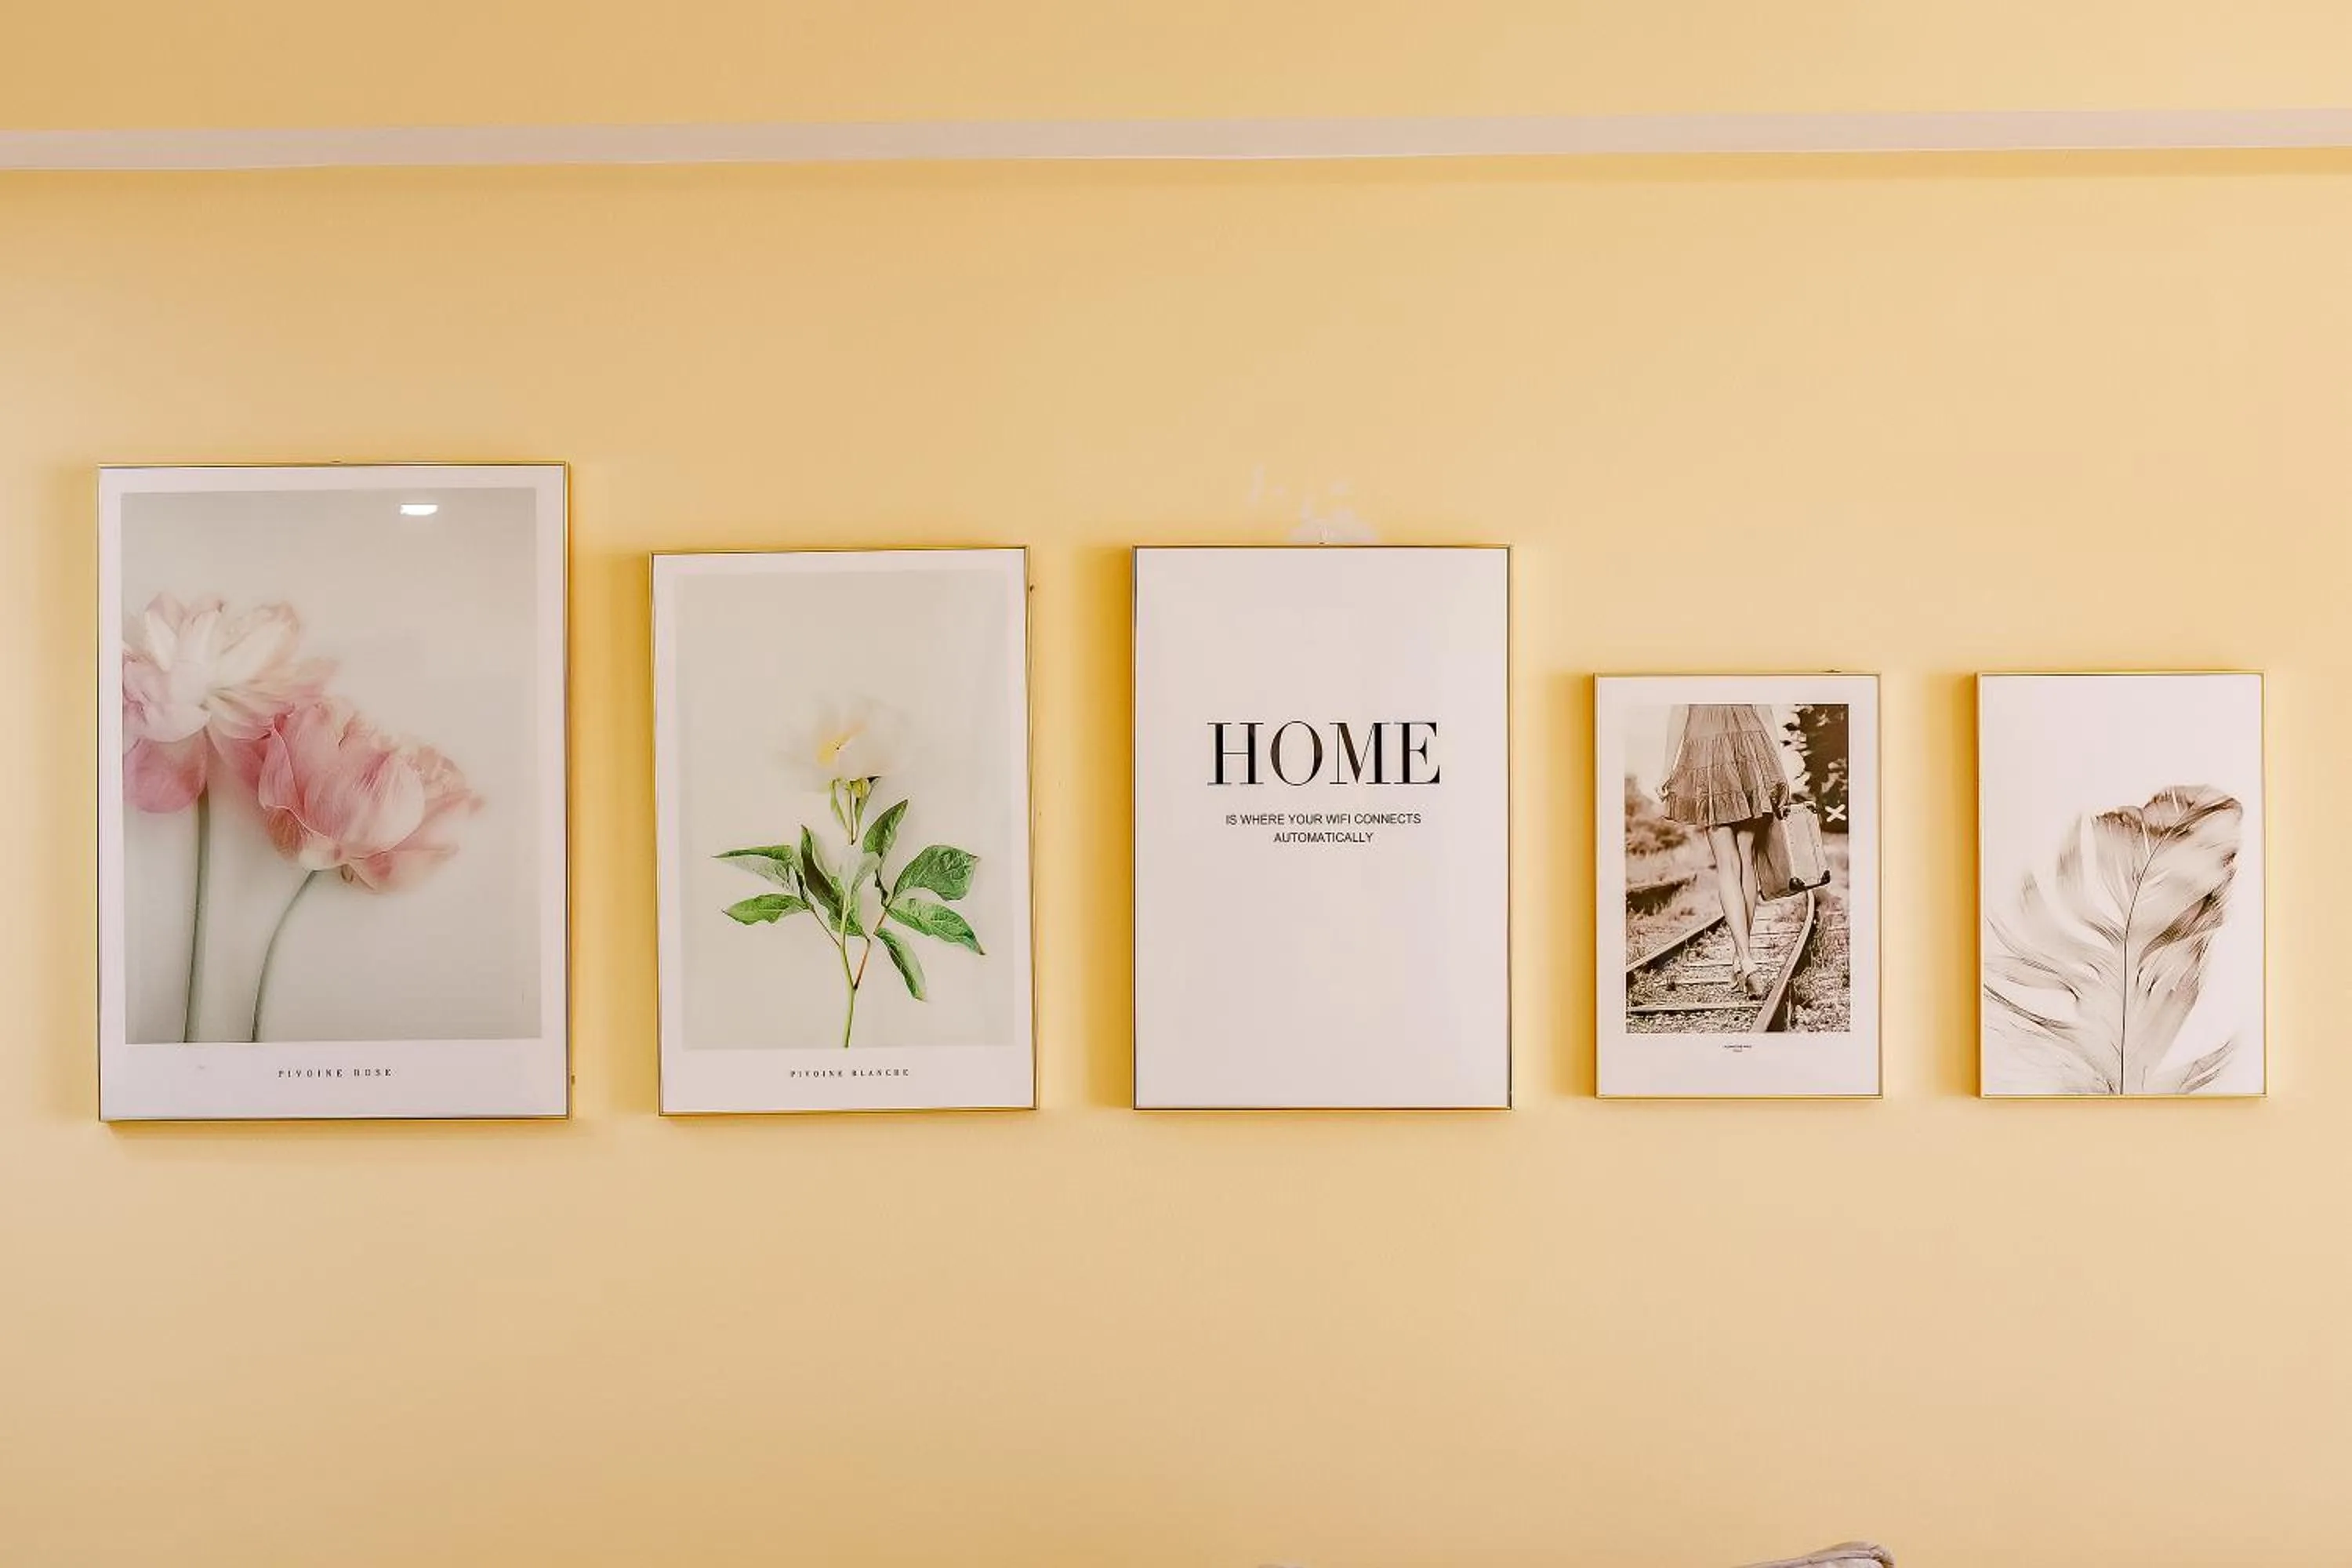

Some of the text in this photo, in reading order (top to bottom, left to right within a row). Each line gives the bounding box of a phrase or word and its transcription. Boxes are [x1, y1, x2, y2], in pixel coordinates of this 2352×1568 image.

[1206, 720, 1441, 786] HOME
[1225, 813, 1421, 826] IS WHERE YOUR WIFI CONNECTS
[1272, 832, 1374, 844] AUTOMATICALLY
[278, 1069, 343, 1078] PIVOINE
[851, 1068, 909, 1077] BLANCHE
